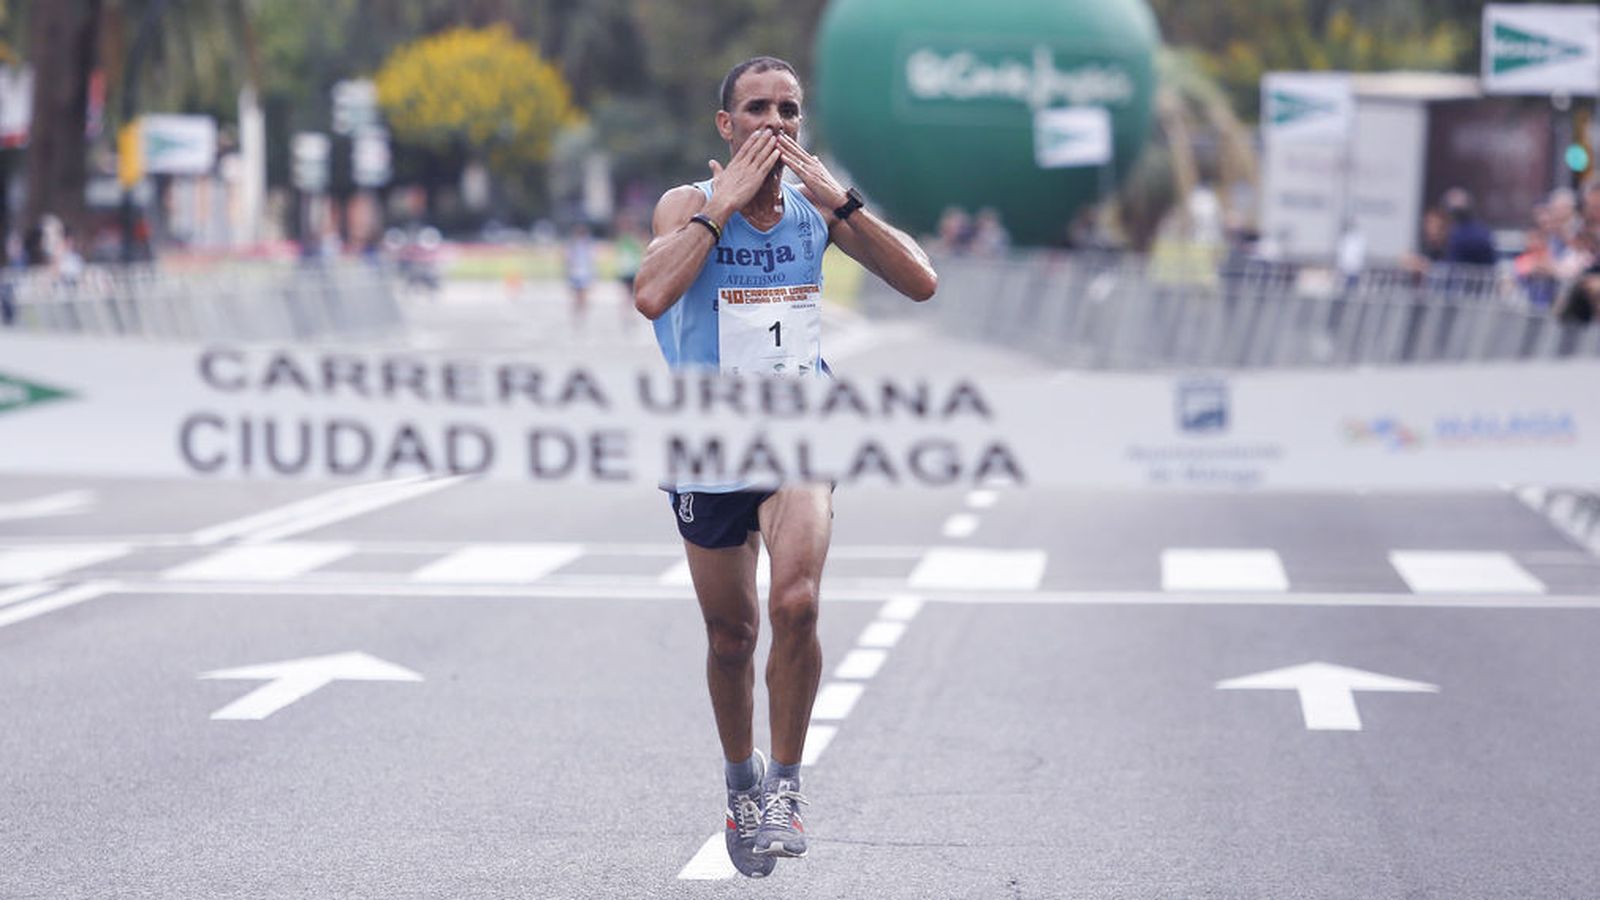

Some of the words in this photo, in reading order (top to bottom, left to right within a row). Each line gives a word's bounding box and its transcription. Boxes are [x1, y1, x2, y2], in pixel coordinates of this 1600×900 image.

[716, 242, 795, 273] nerja
[725, 273, 786, 286] ATLETISMO
[721, 289, 744, 304] 40
[768, 321, 781, 347] 1
[197, 347, 610, 407] CARRERA
[635, 371, 993, 420] URBANA
[178, 411, 496, 479] CIUDAD
[527, 427, 632, 482] DE
[664, 426, 1027, 487] MÁLAGA
